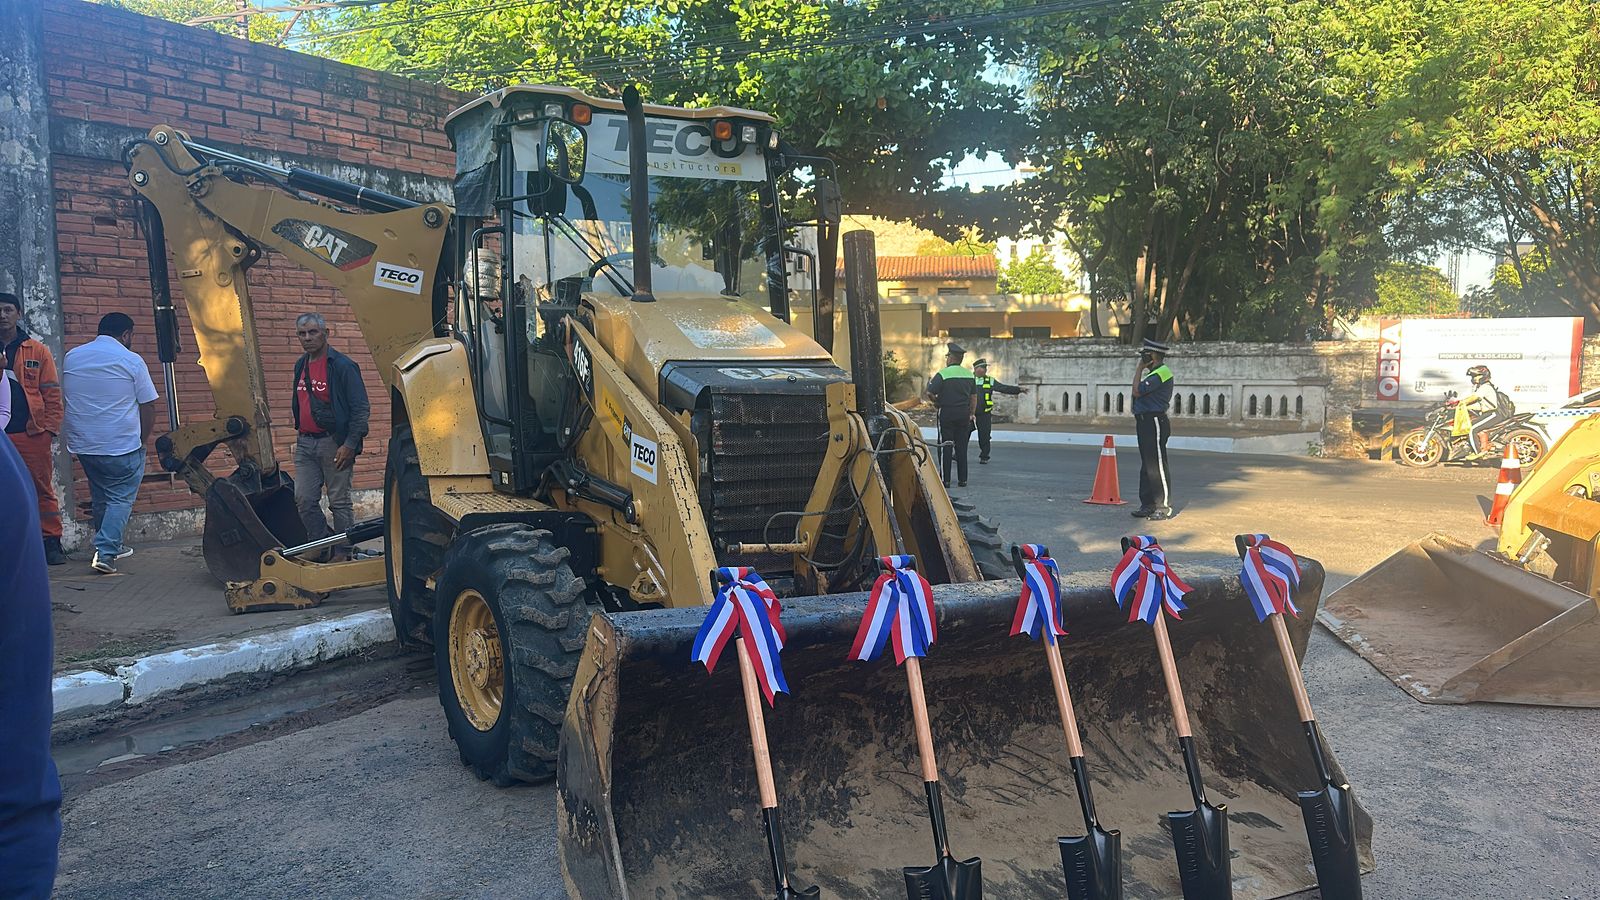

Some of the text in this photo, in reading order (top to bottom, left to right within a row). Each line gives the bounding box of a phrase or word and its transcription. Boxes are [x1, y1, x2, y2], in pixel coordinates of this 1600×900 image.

[608, 119, 748, 158] TECO
[646, 160, 737, 173] nstructora
[304, 225, 349, 264] CAT
[380, 267, 420, 284] TECO
[1379, 322, 1402, 397] OBRA
[717, 367, 828, 380] CAT
[633, 442, 656, 466] TECO
